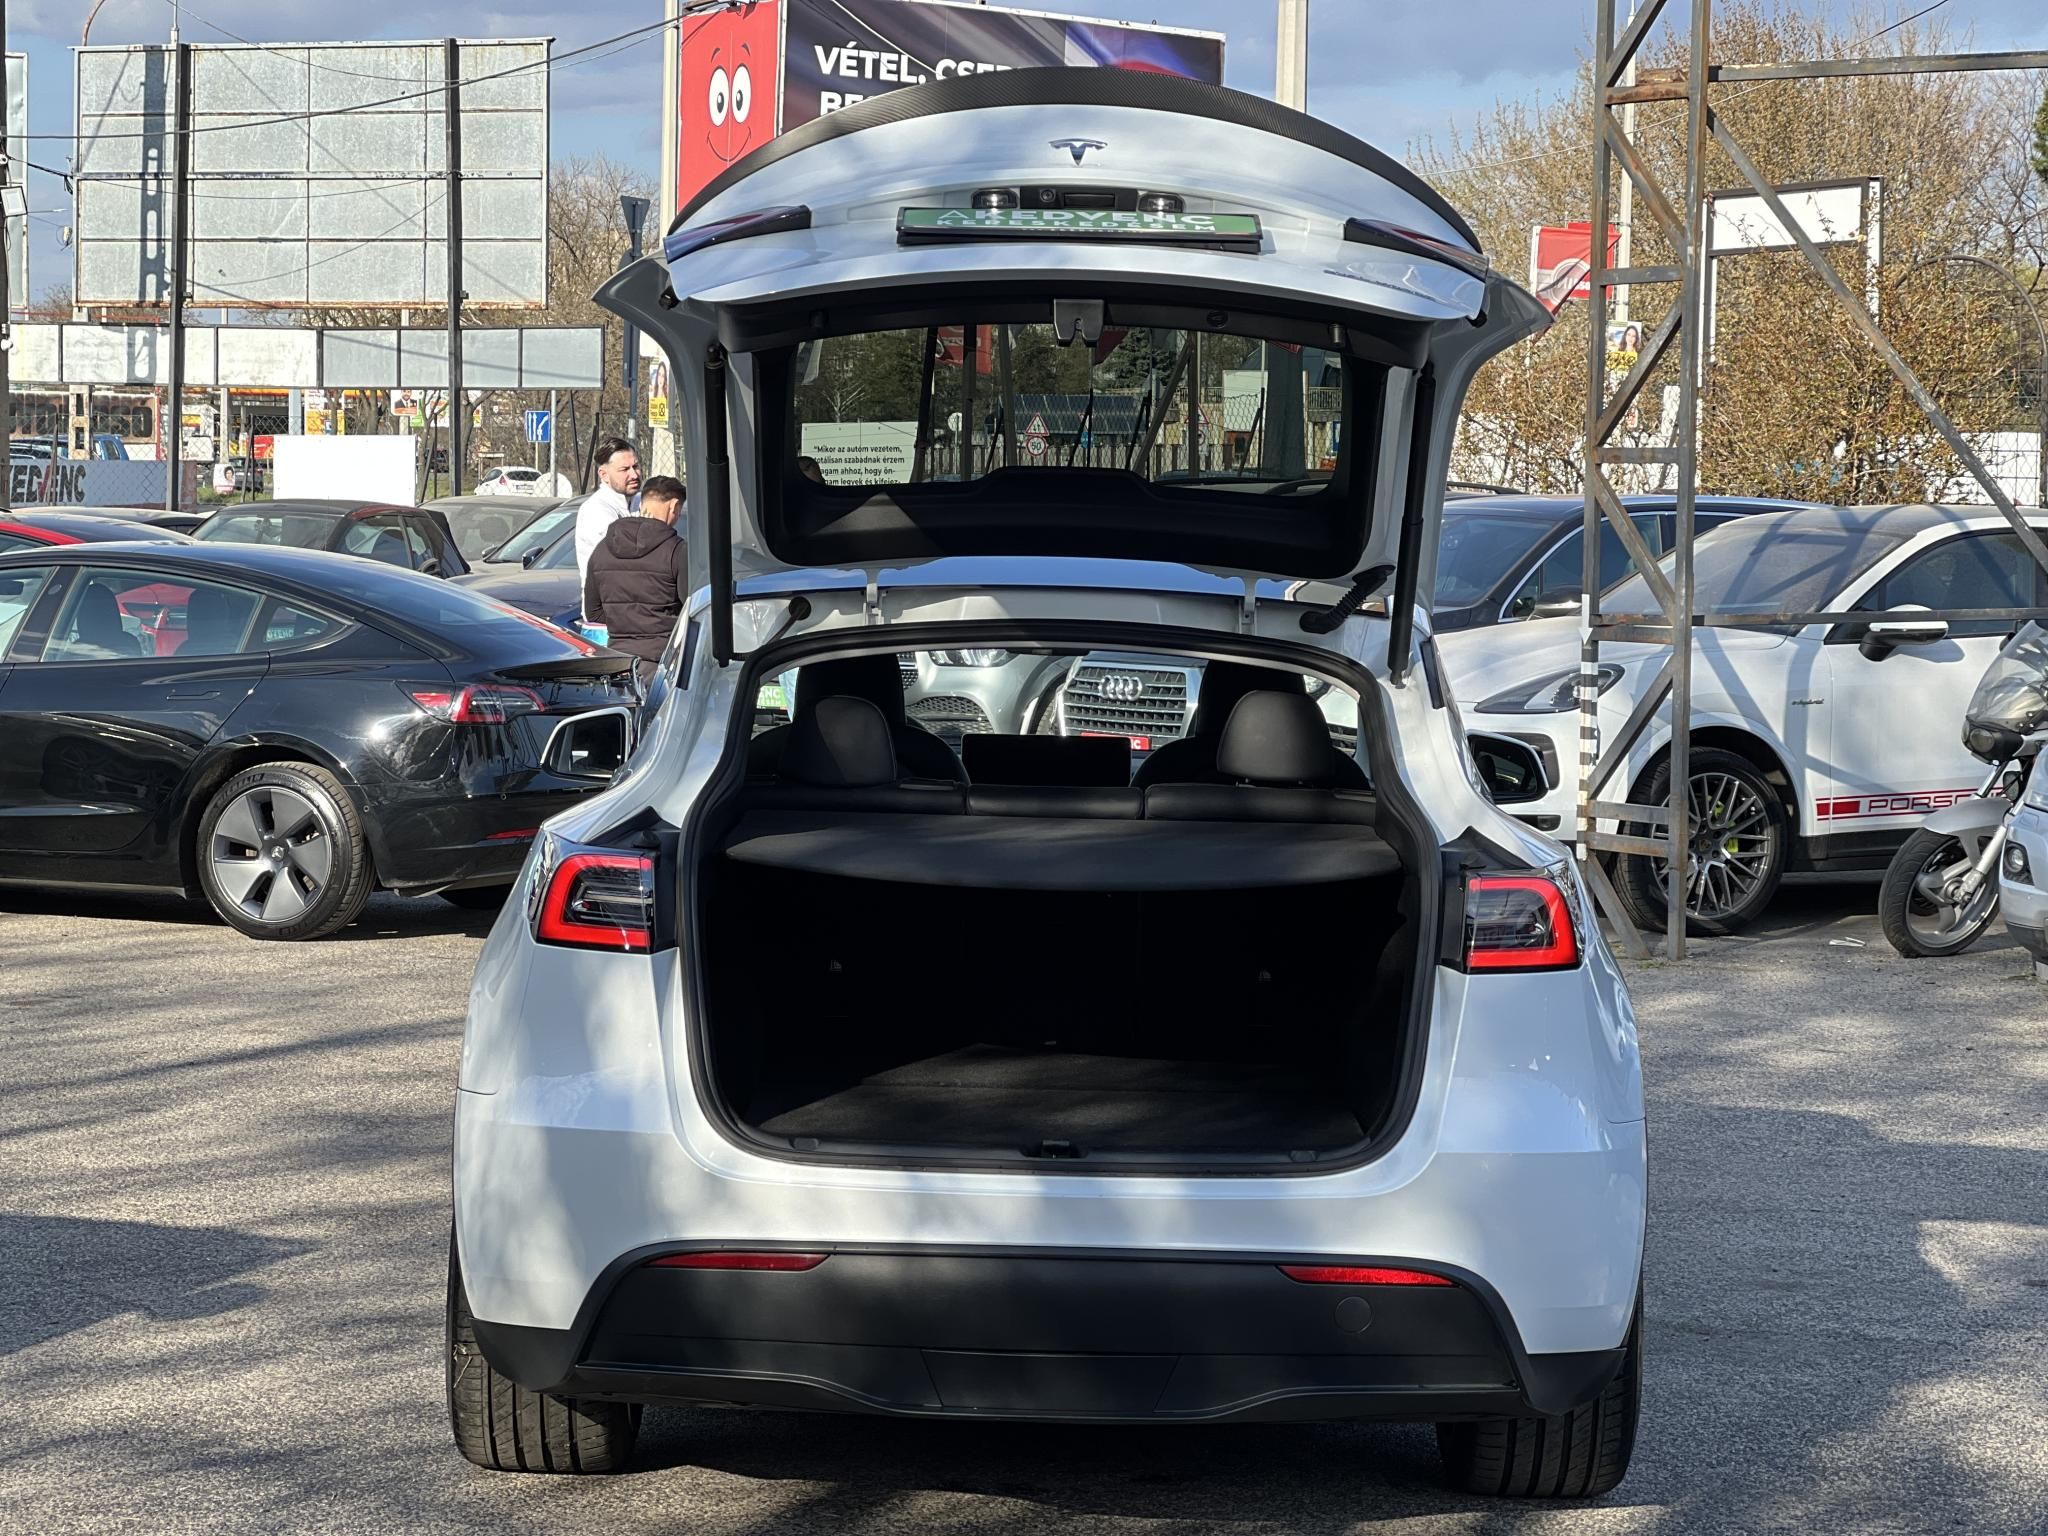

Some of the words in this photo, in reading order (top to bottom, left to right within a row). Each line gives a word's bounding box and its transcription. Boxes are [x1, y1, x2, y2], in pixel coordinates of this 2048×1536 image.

[814, 41, 927, 84] VÉTEL.
[935, 58, 1014, 81] CS
[844, 455, 880, 464] szabadnak
[864, 466, 882, 476] hogy
[10, 464, 86, 503] EDVENC
